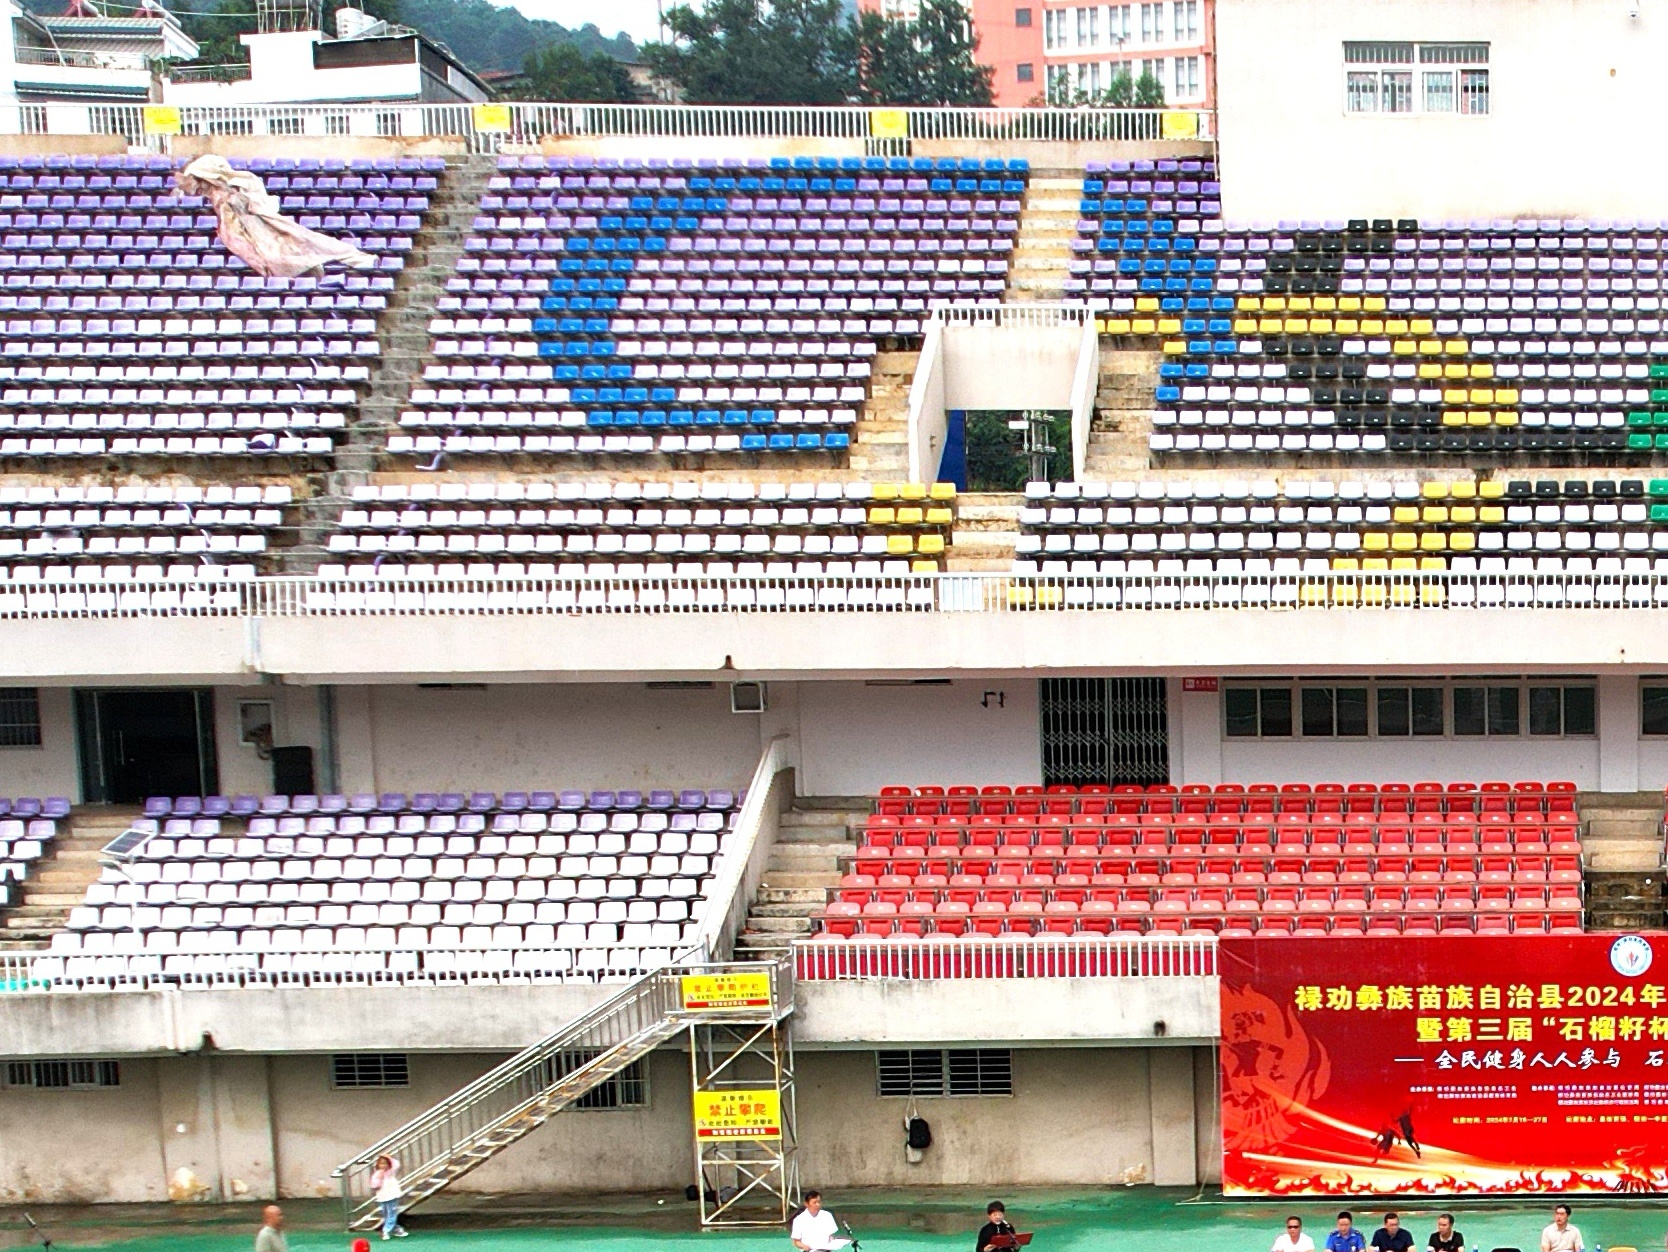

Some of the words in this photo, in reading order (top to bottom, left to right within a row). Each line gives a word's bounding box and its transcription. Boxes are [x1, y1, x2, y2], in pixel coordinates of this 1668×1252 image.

[1435, 1047, 1621, 1070] 全民健身人人参与
